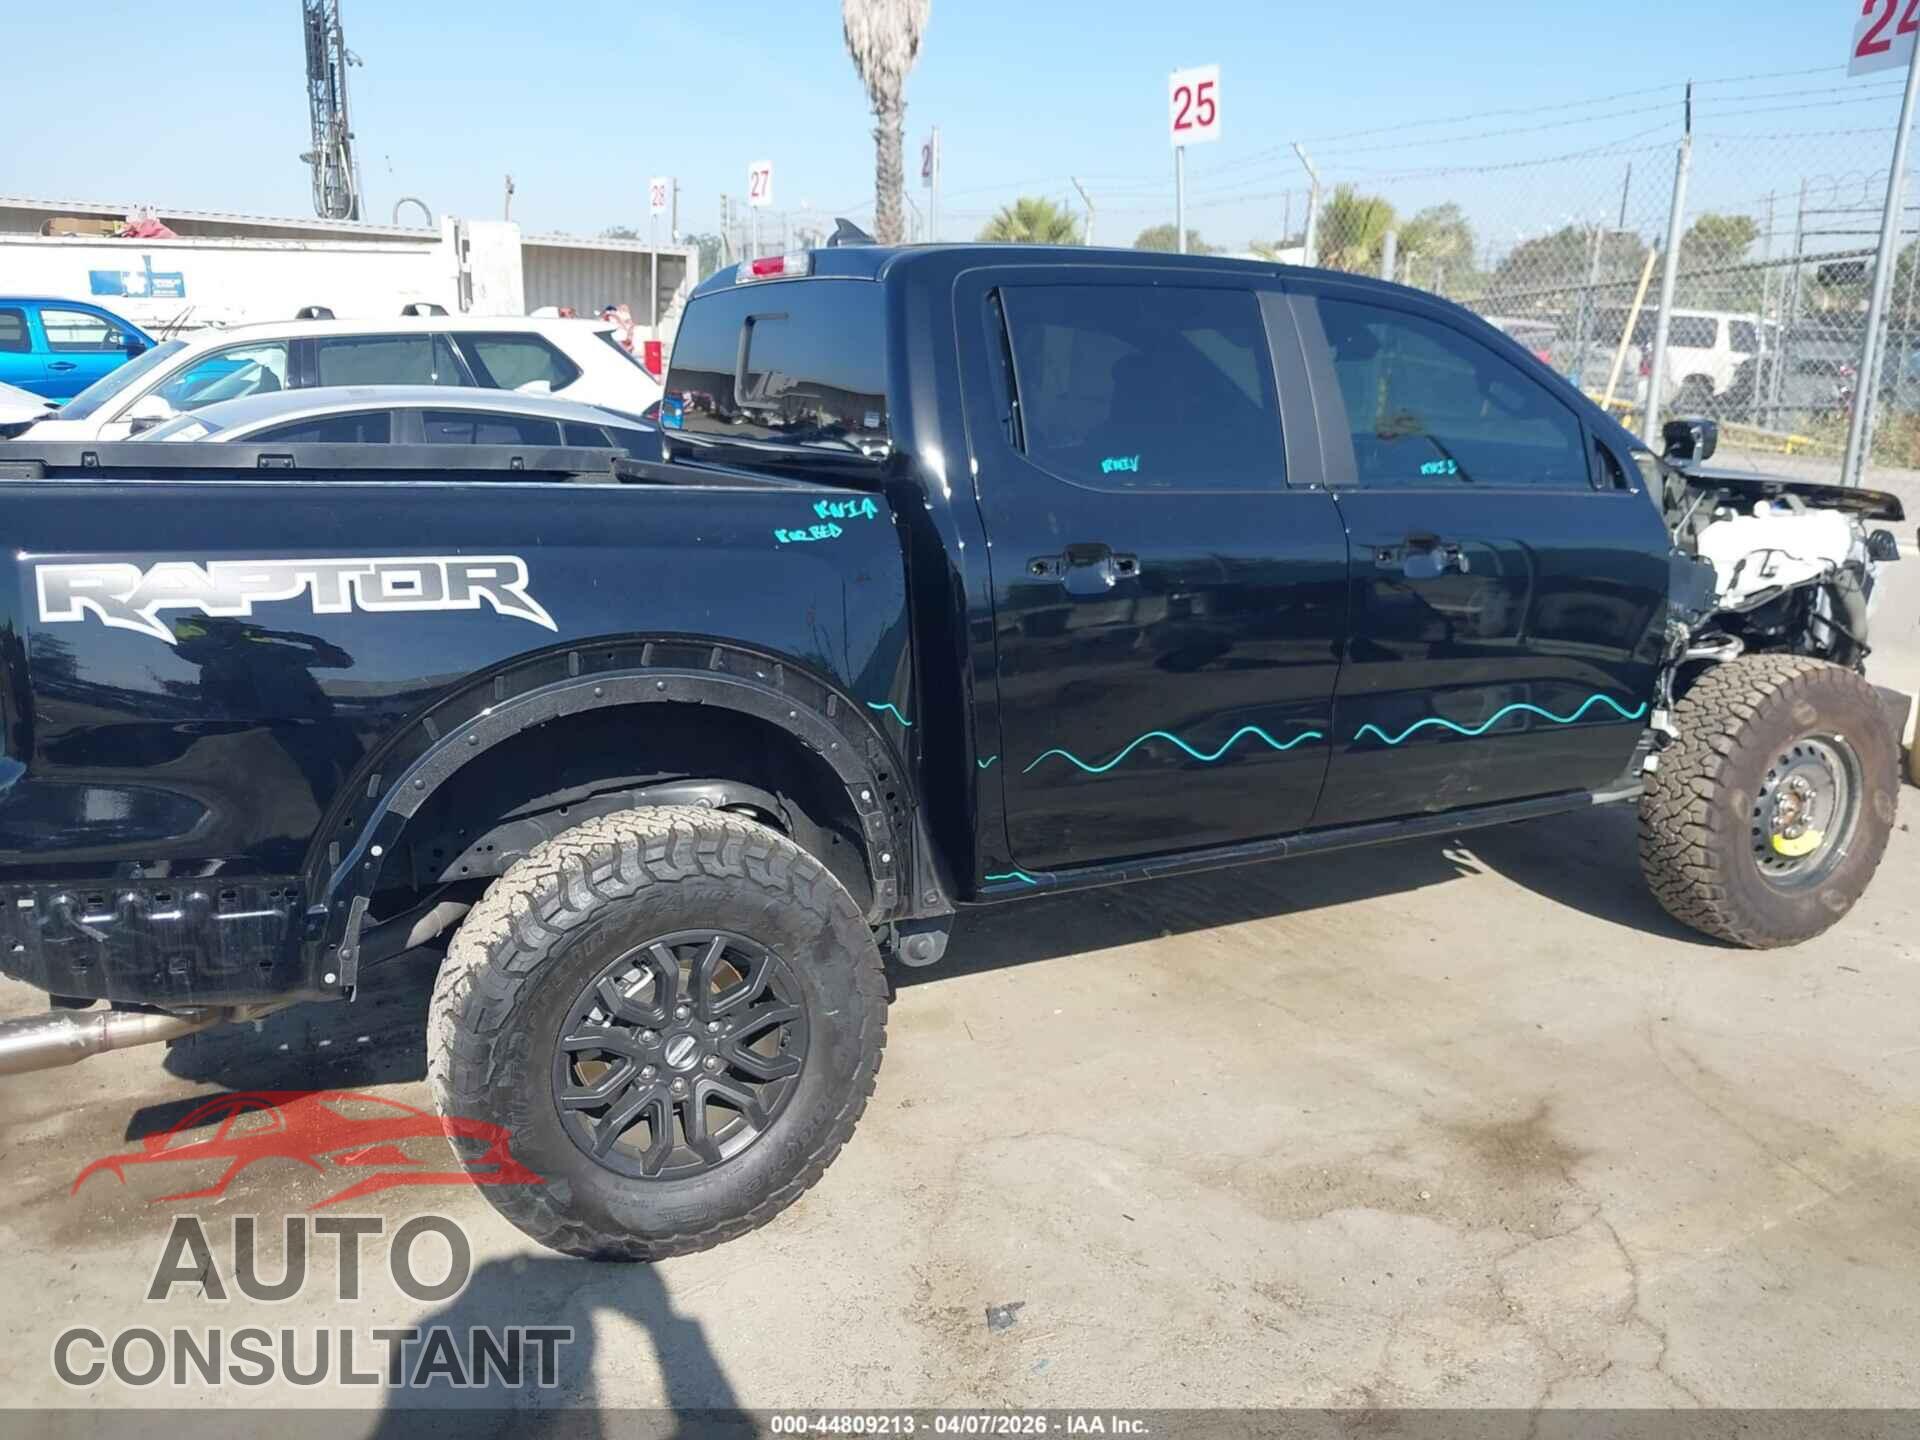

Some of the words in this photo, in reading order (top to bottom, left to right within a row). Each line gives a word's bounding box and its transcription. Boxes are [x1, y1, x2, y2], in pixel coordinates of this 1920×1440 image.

[1173, 81, 1215, 130] 25
[751, 170, 769, 197] 27
[35, 554, 559, 645] RAPTOR
